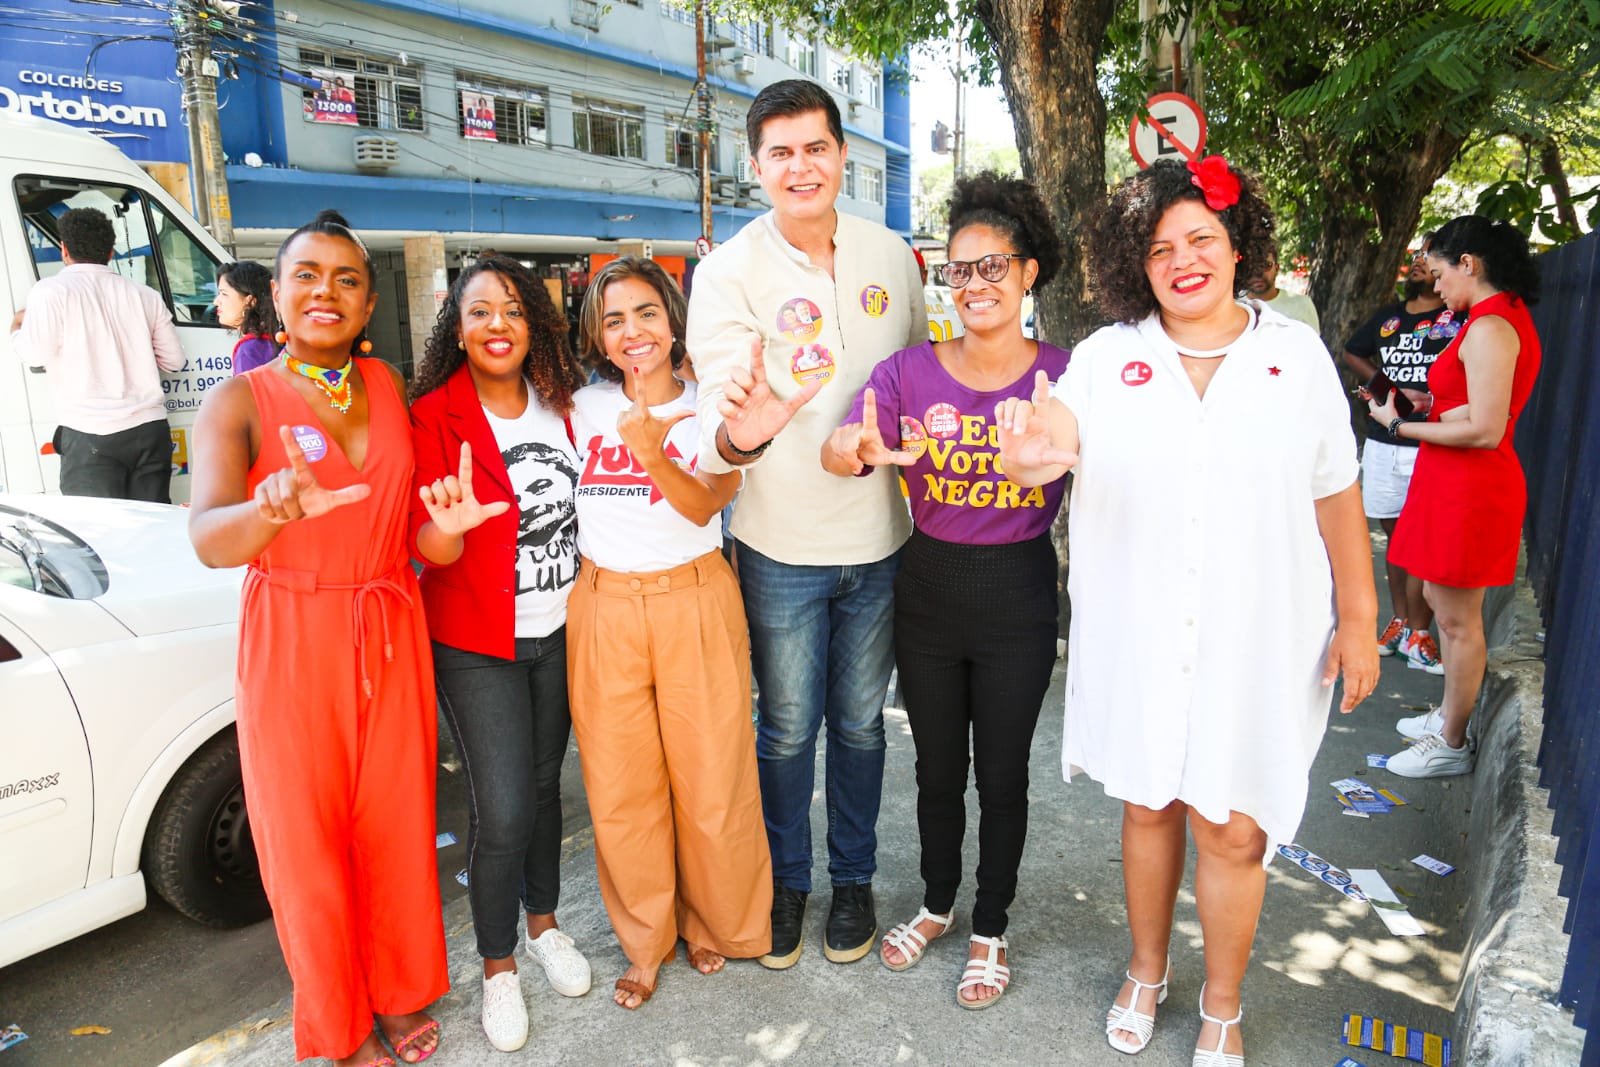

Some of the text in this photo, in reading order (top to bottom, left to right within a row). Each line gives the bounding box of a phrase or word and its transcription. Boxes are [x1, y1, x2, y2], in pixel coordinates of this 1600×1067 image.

[19, 70, 123, 92] COLCHÕES
[0, 86, 168, 128] Ortobom
[317, 100, 353, 113] 13000
[866, 291, 883, 314] 50
[577, 486, 651, 498] PRESIDENTE
[923, 473, 1046, 508] NEGRA
